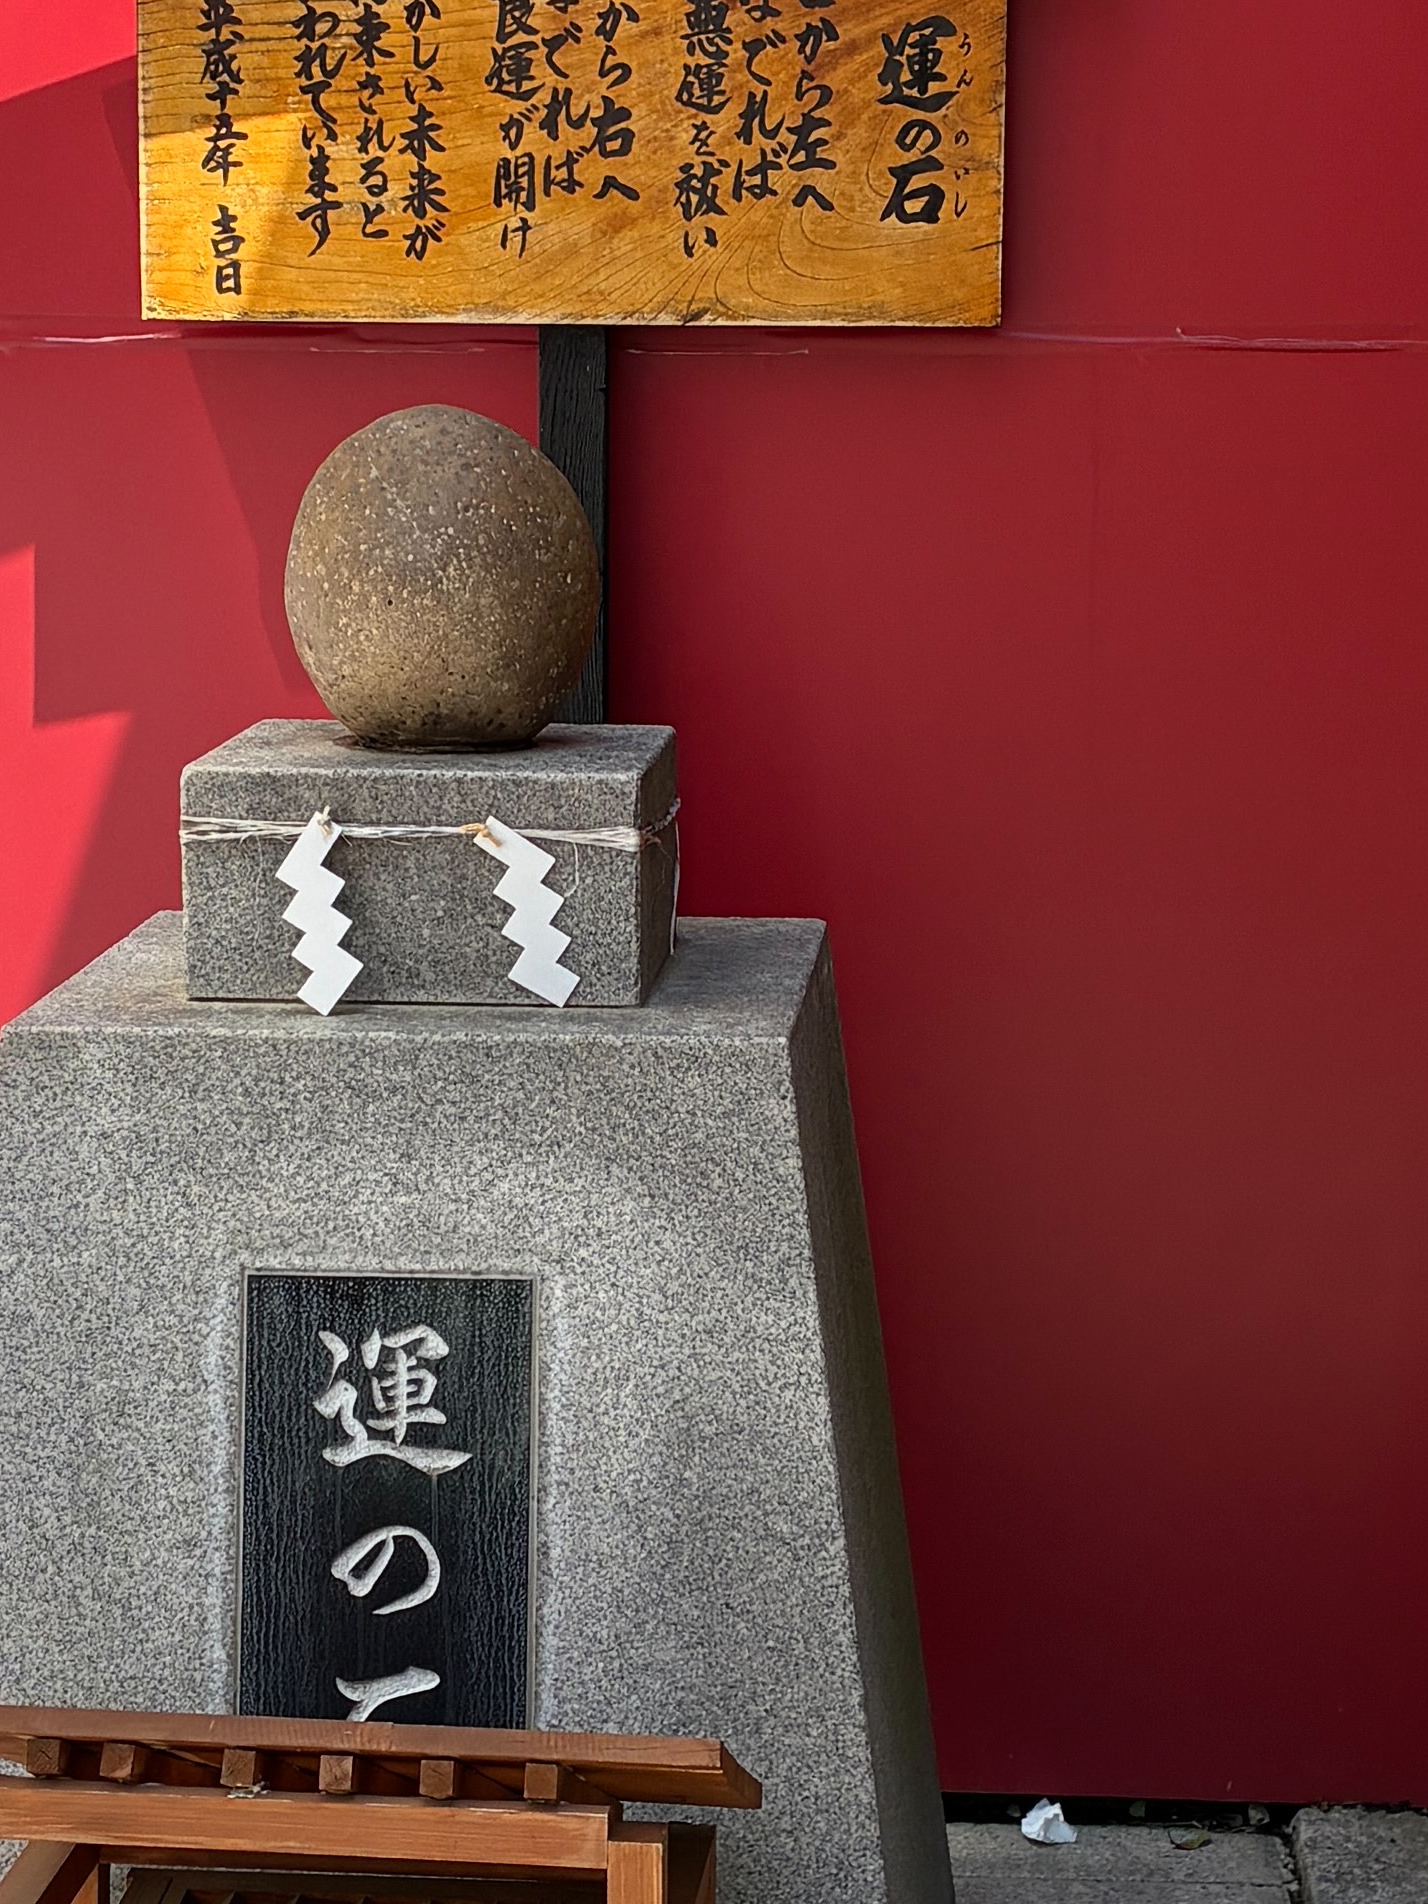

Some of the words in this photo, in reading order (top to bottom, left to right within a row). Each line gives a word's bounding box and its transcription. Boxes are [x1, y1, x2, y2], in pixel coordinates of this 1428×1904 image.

[877, 14, 960, 225] 運の石
[212, 207, 244, 294] 吉日
